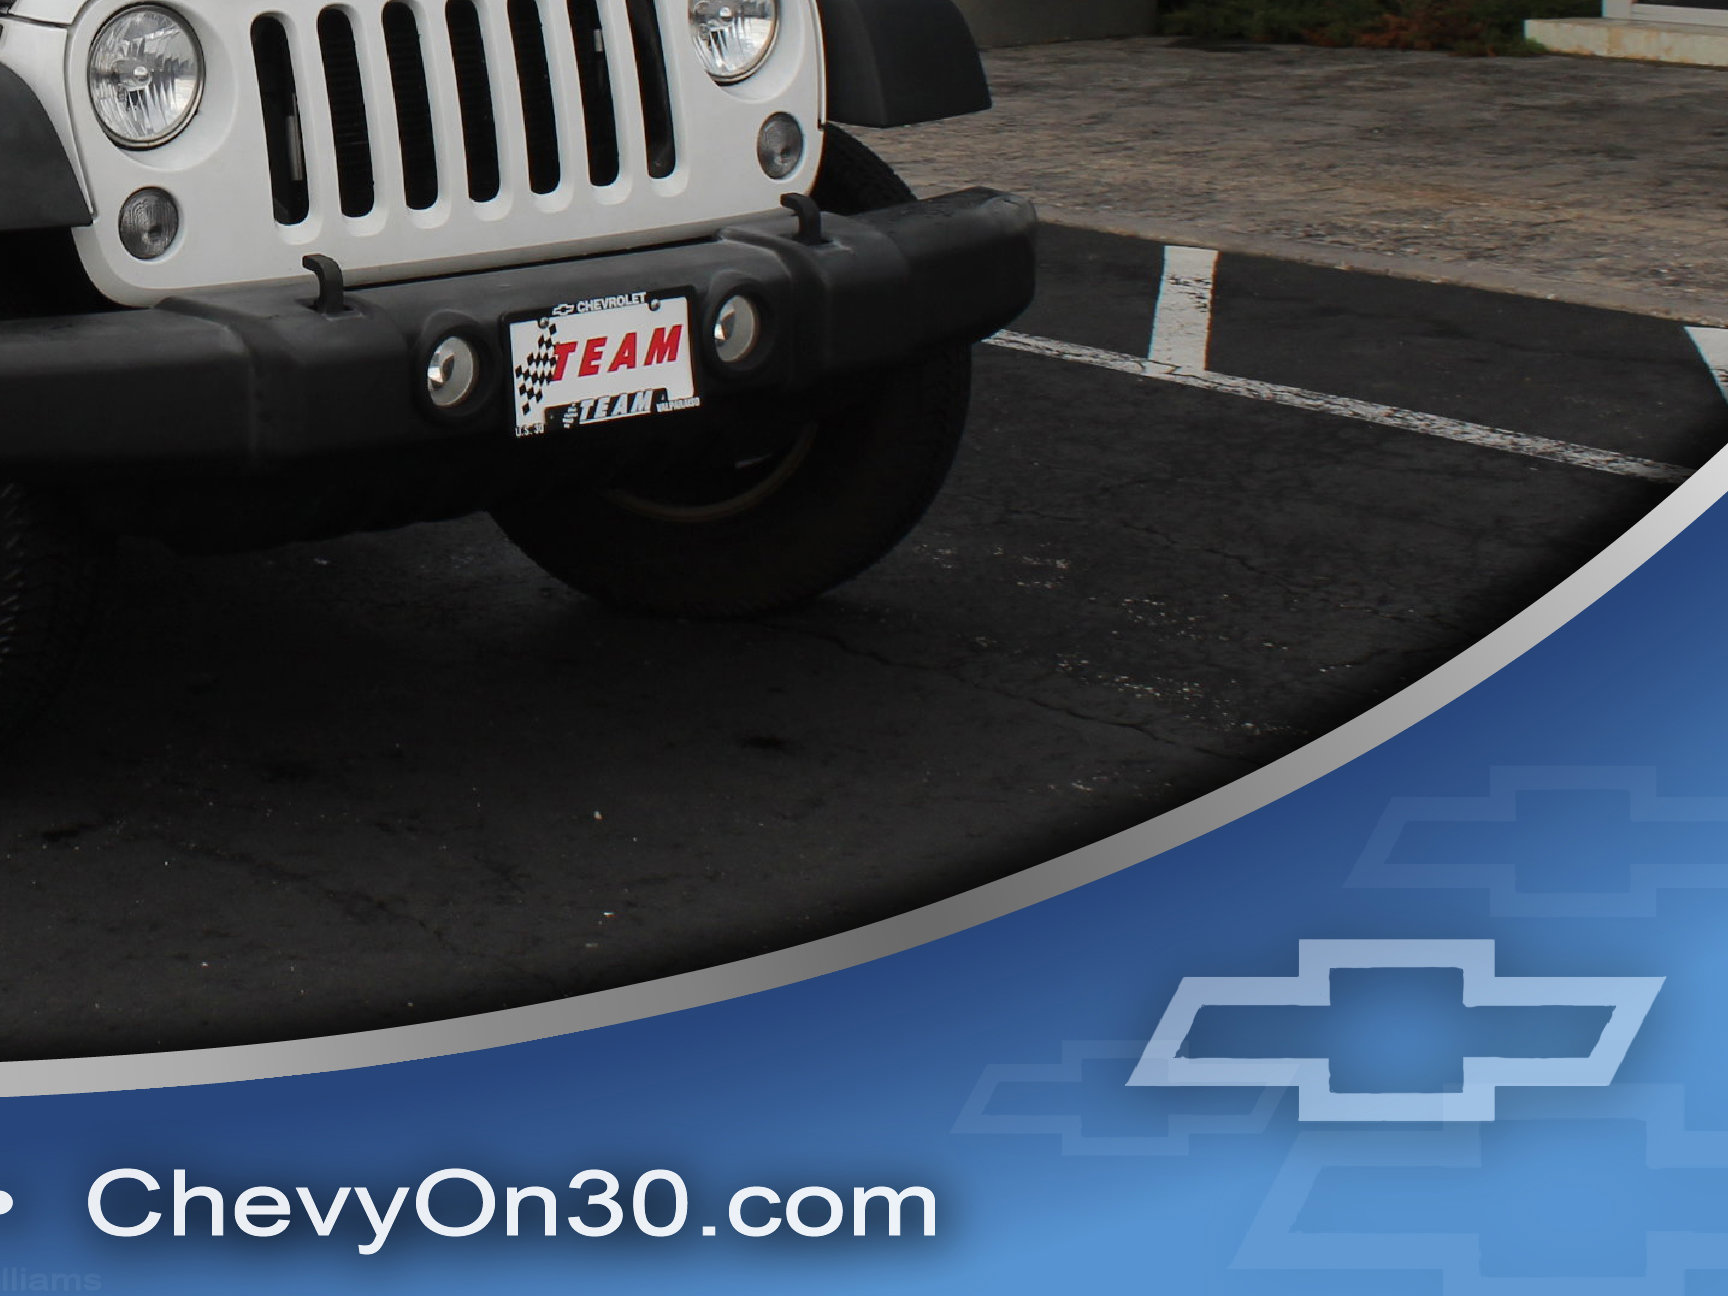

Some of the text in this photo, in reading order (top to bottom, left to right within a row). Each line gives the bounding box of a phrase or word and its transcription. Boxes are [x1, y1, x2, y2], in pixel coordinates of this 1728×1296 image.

[578, 291, 647, 314] CHEVROLET
[551, 323, 684, 382] TEAM
[578, 390, 654, 425] TEAM
